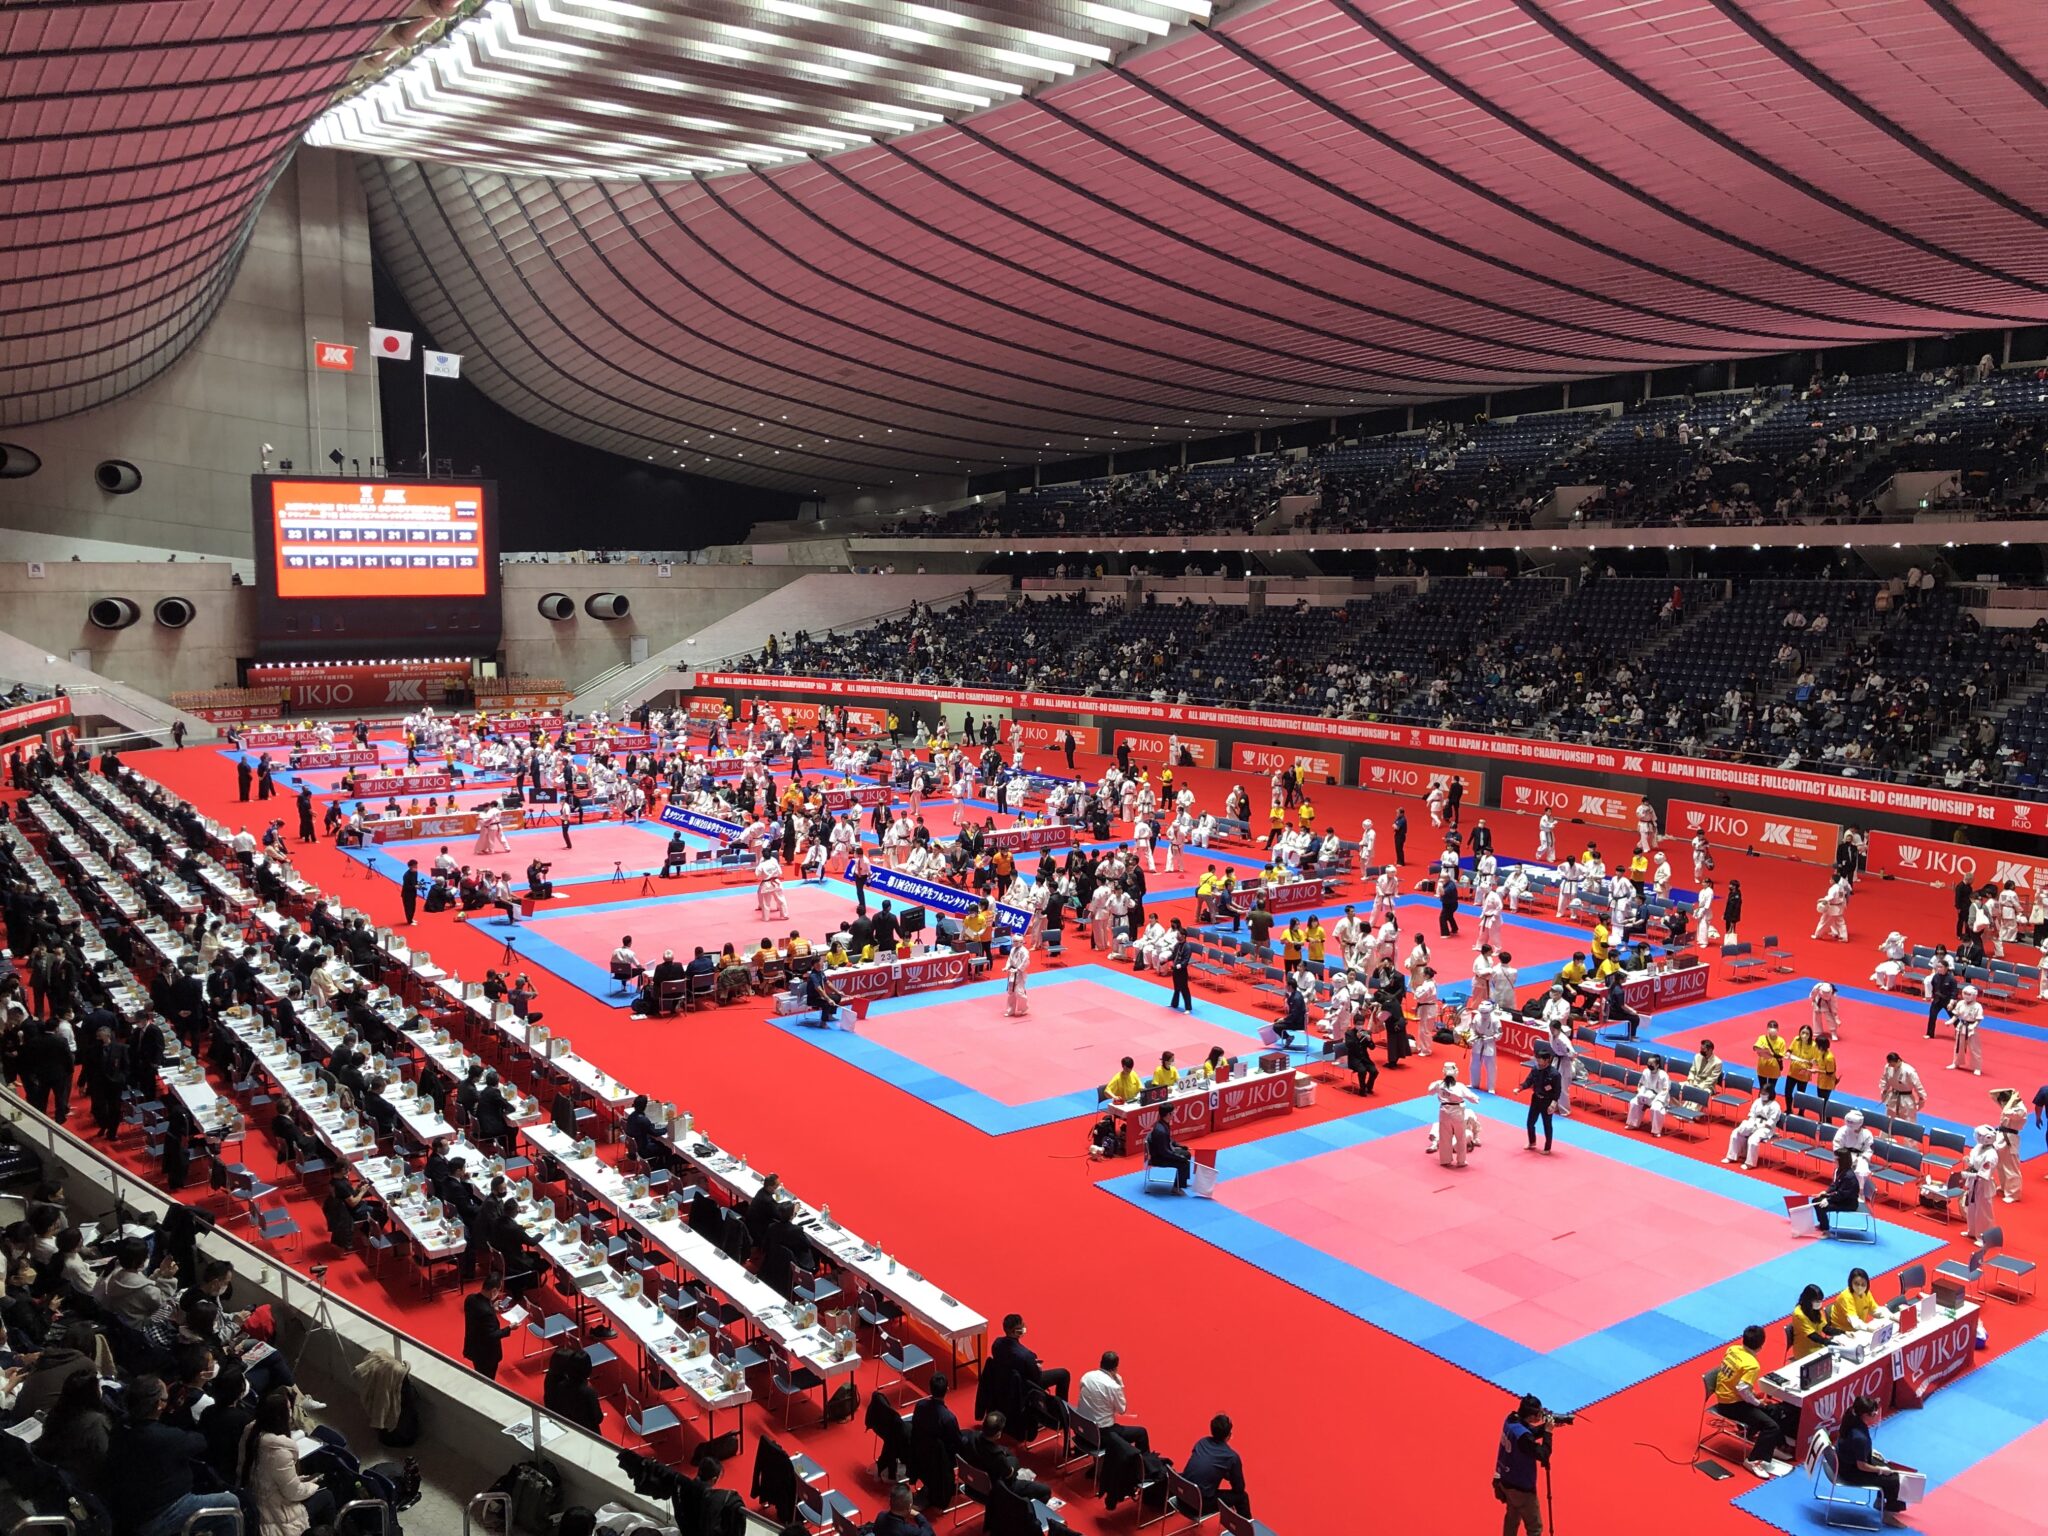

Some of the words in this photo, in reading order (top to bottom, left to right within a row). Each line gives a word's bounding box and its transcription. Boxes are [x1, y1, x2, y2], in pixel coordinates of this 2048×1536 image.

[298, 684, 353, 705] JKJO
[1046, 698, 1054, 707] ALL
[1055, 699, 1071, 708] JAPAN
[1078, 701, 1108, 712] KARATE-DO
[1108, 704, 1150, 715] CHAMPIONSHIP
[1025, 727, 1048, 740] JKJO
[1188, 711, 1200, 720] ALL
[1200, 712, 1217, 722] JAPAN
[1218, 714, 1259, 726] INTERCOLLEGE
[1260, 717, 1301, 730] FULLCONTACT
[1302, 721, 1336, 734] KARATE-DO
[1338, 724, 1389, 739] CHAMPIONSHIP
[1390, 730, 1400, 741] 1st
[1139, 739, 1163, 753] JKJO
[1429, 734, 1444, 746] JKJO
[1444, 736, 1457, 748] ALL
[1458, 738, 1481, 750] JAPAN
[1482, 740, 1490, 752] Jr.
[1491, 742, 1532, 756] KARATE-DO
[1534, 747, 1595, 764] CHAMPIONSHIP
[1597, 755, 1615, 767] 16th
[352, 752, 374, 761] JKJO
[1257, 753, 1284, 768] JKJO
[374, 780, 398, 791] JKJO
[422, 778, 446, 787] JKJO
[1388, 769, 1418, 786] JKJO
[866, 790, 887, 800] JKJO
[1534, 790, 1568, 808] JKJO
[1652, 761, 1666, 773] ALL
[1667, 763, 1695, 777] JAPAN
[1696, 766, 1759, 785] INTERCOLLEGE
[1761, 774, 1826, 794] FULLCONTACT
[1828, 784, 1884, 804] KARATE-DO
[1888, 793, 1974, 816] CHAMPIONSHIP
[1976, 804, 1994, 820] 1st
[406, 820, 412, 828] D
[1708, 815, 1748, 836] JKJO
[2012, 819, 2031, 829] JKJO
[1043, 830, 1066, 842] JKJO
[1925, 850, 1976, 875] JKJO
[1292, 885, 1317, 899] JKJO
[894, 967, 899, 977] F
[927, 960, 963, 980] JKJO
[851, 972, 887, 992] JKJO
[1679, 971, 1706, 992] JKJO
[1180, 1078, 1197, 1090] 022
[1210, 1092, 1218, 1107] G
[1248, 1080, 1287, 1106] JKJO
[1172, 1100, 1204, 1123] KJO
[1930, 1323, 1970, 1370] JKJO
[1894, 1352, 1904, 1378] H
